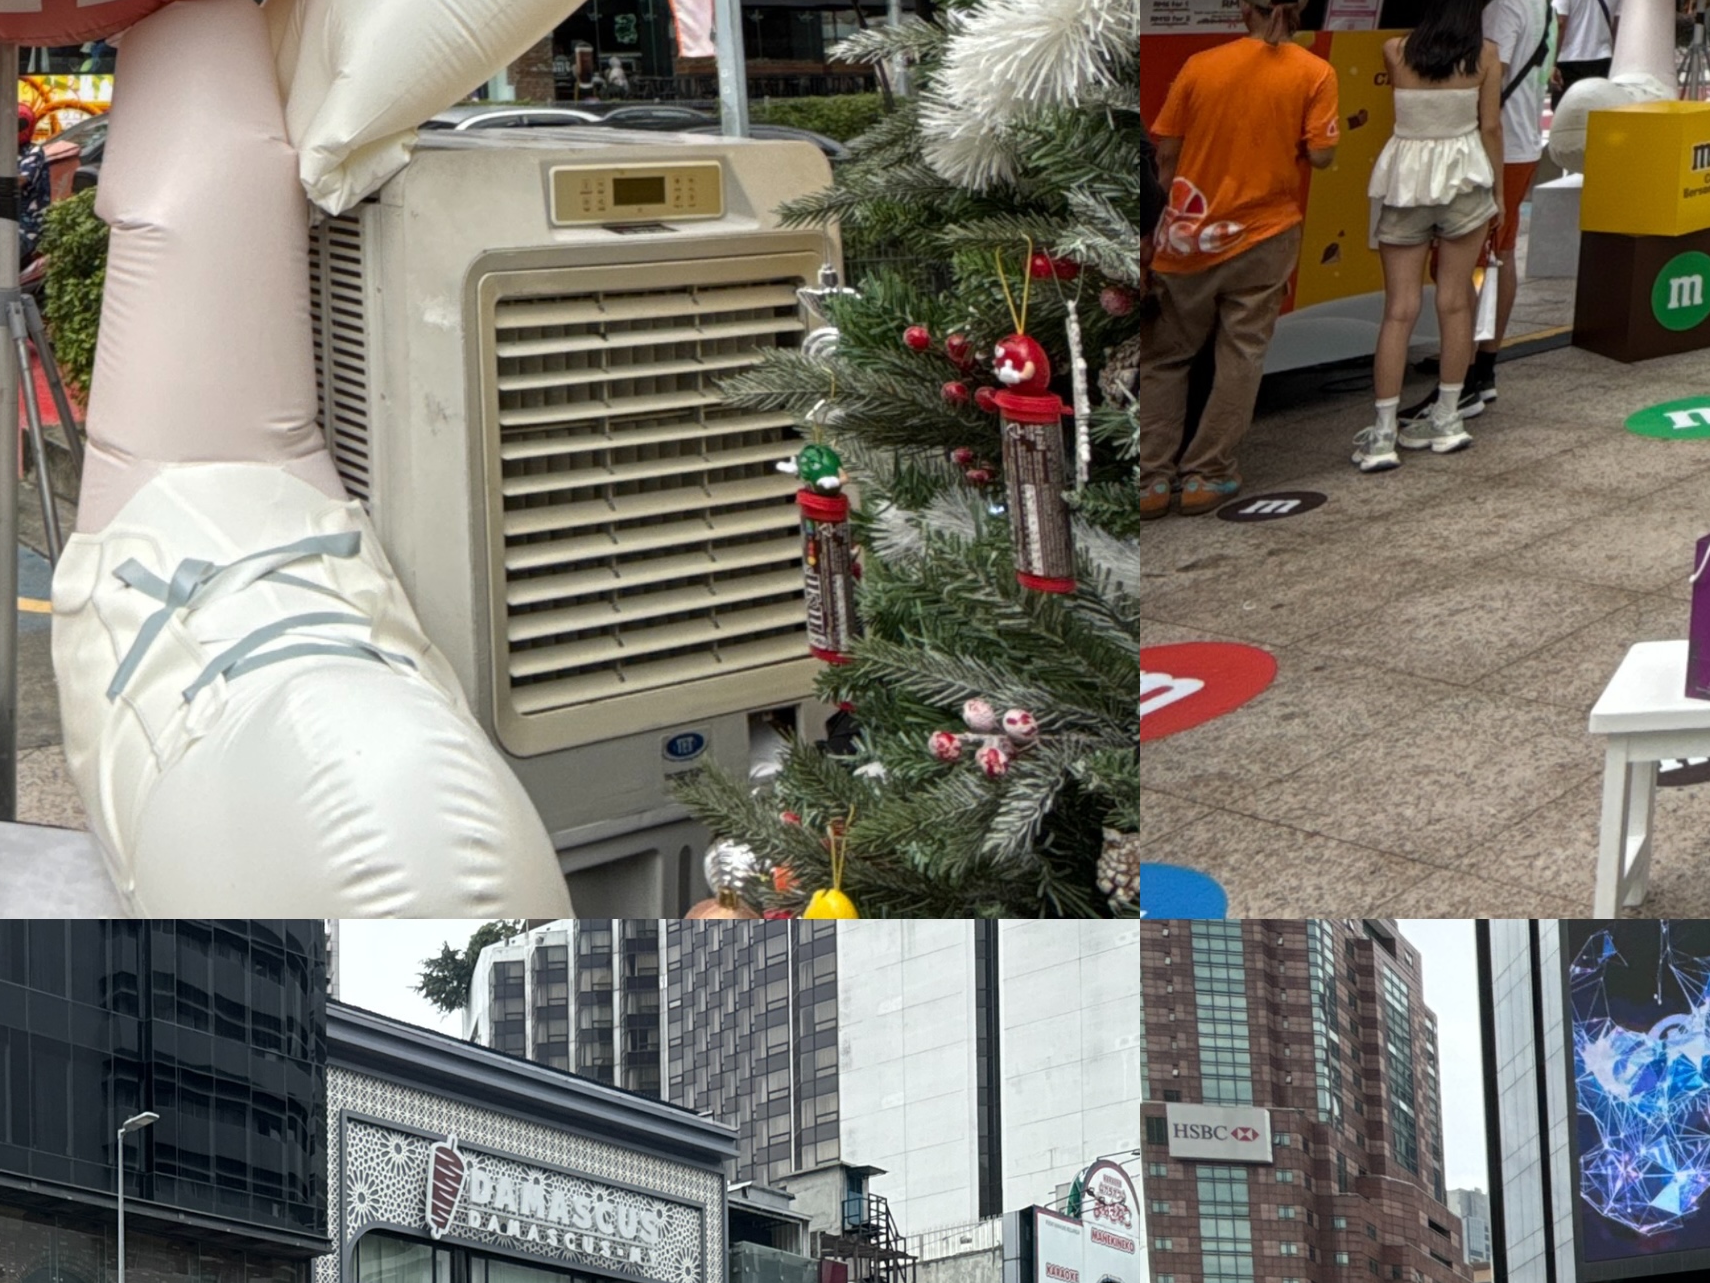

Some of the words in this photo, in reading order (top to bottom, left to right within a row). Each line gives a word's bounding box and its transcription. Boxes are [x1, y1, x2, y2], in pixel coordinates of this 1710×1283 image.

[1172, 1122, 1229, 1141] HSBC
[467, 1168, 660, 1244] DAMASCUS
[1090, 1226, 1136, 1255] MANEKINEKO
